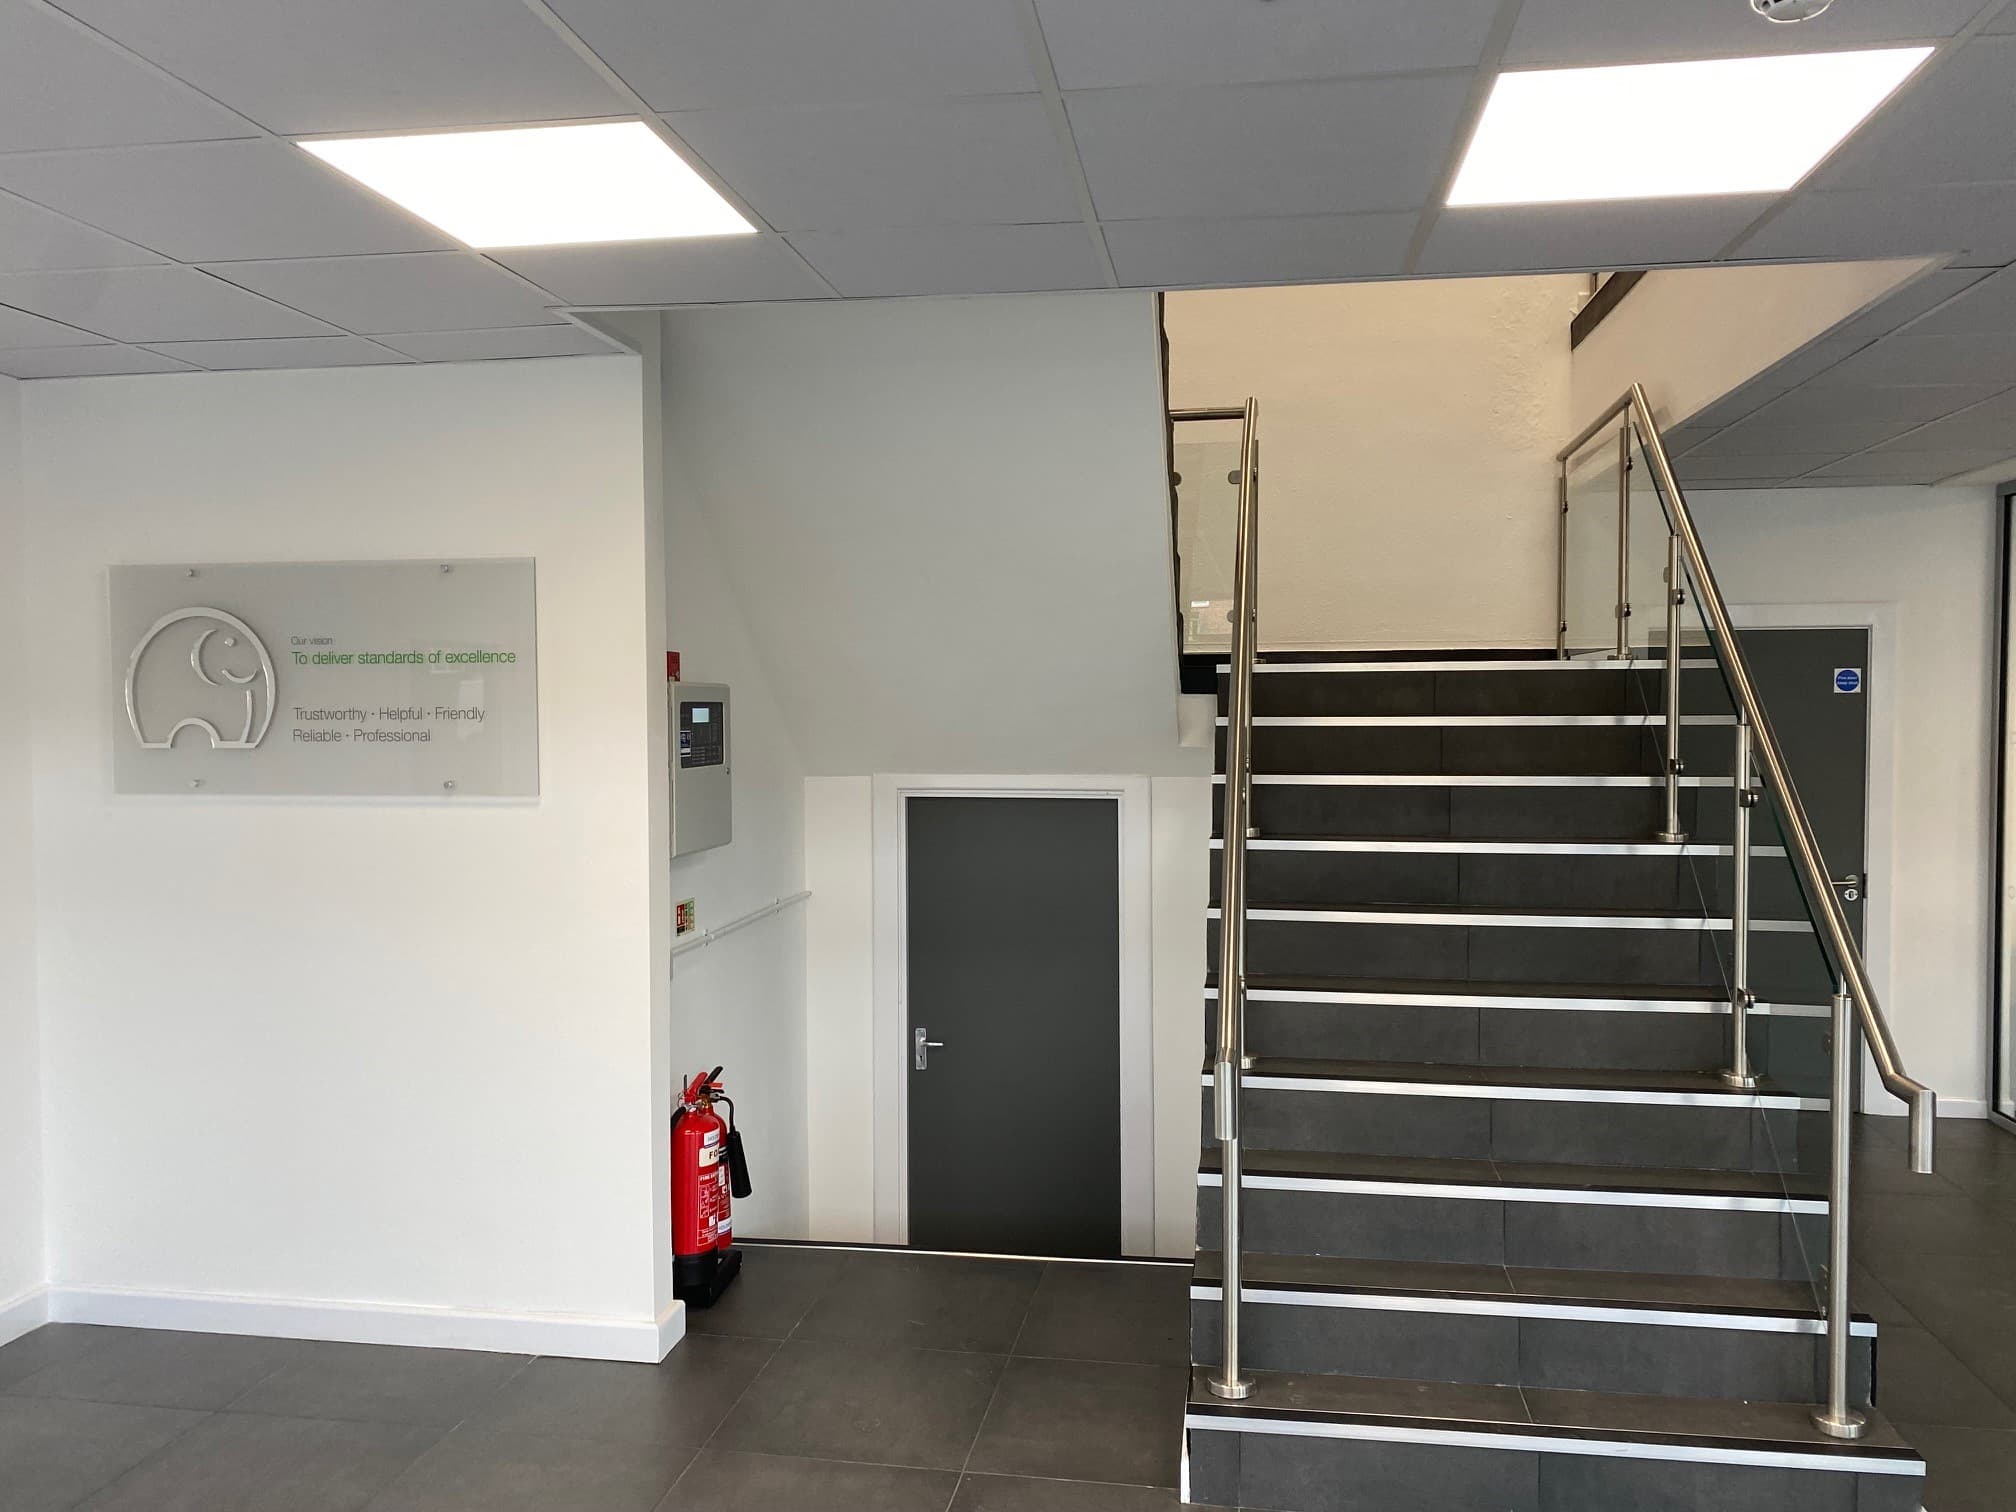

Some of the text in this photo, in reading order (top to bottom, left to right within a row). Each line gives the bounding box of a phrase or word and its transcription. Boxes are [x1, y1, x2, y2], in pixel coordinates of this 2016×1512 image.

[290, 636, 333, 646] Our vision
[291, 650, 517, 665] To deliver standards of excellence
[292, 706, 485, 723] Trustworthy Helpful Friendly
[292, 728, 431, 743] Reliable Professional
